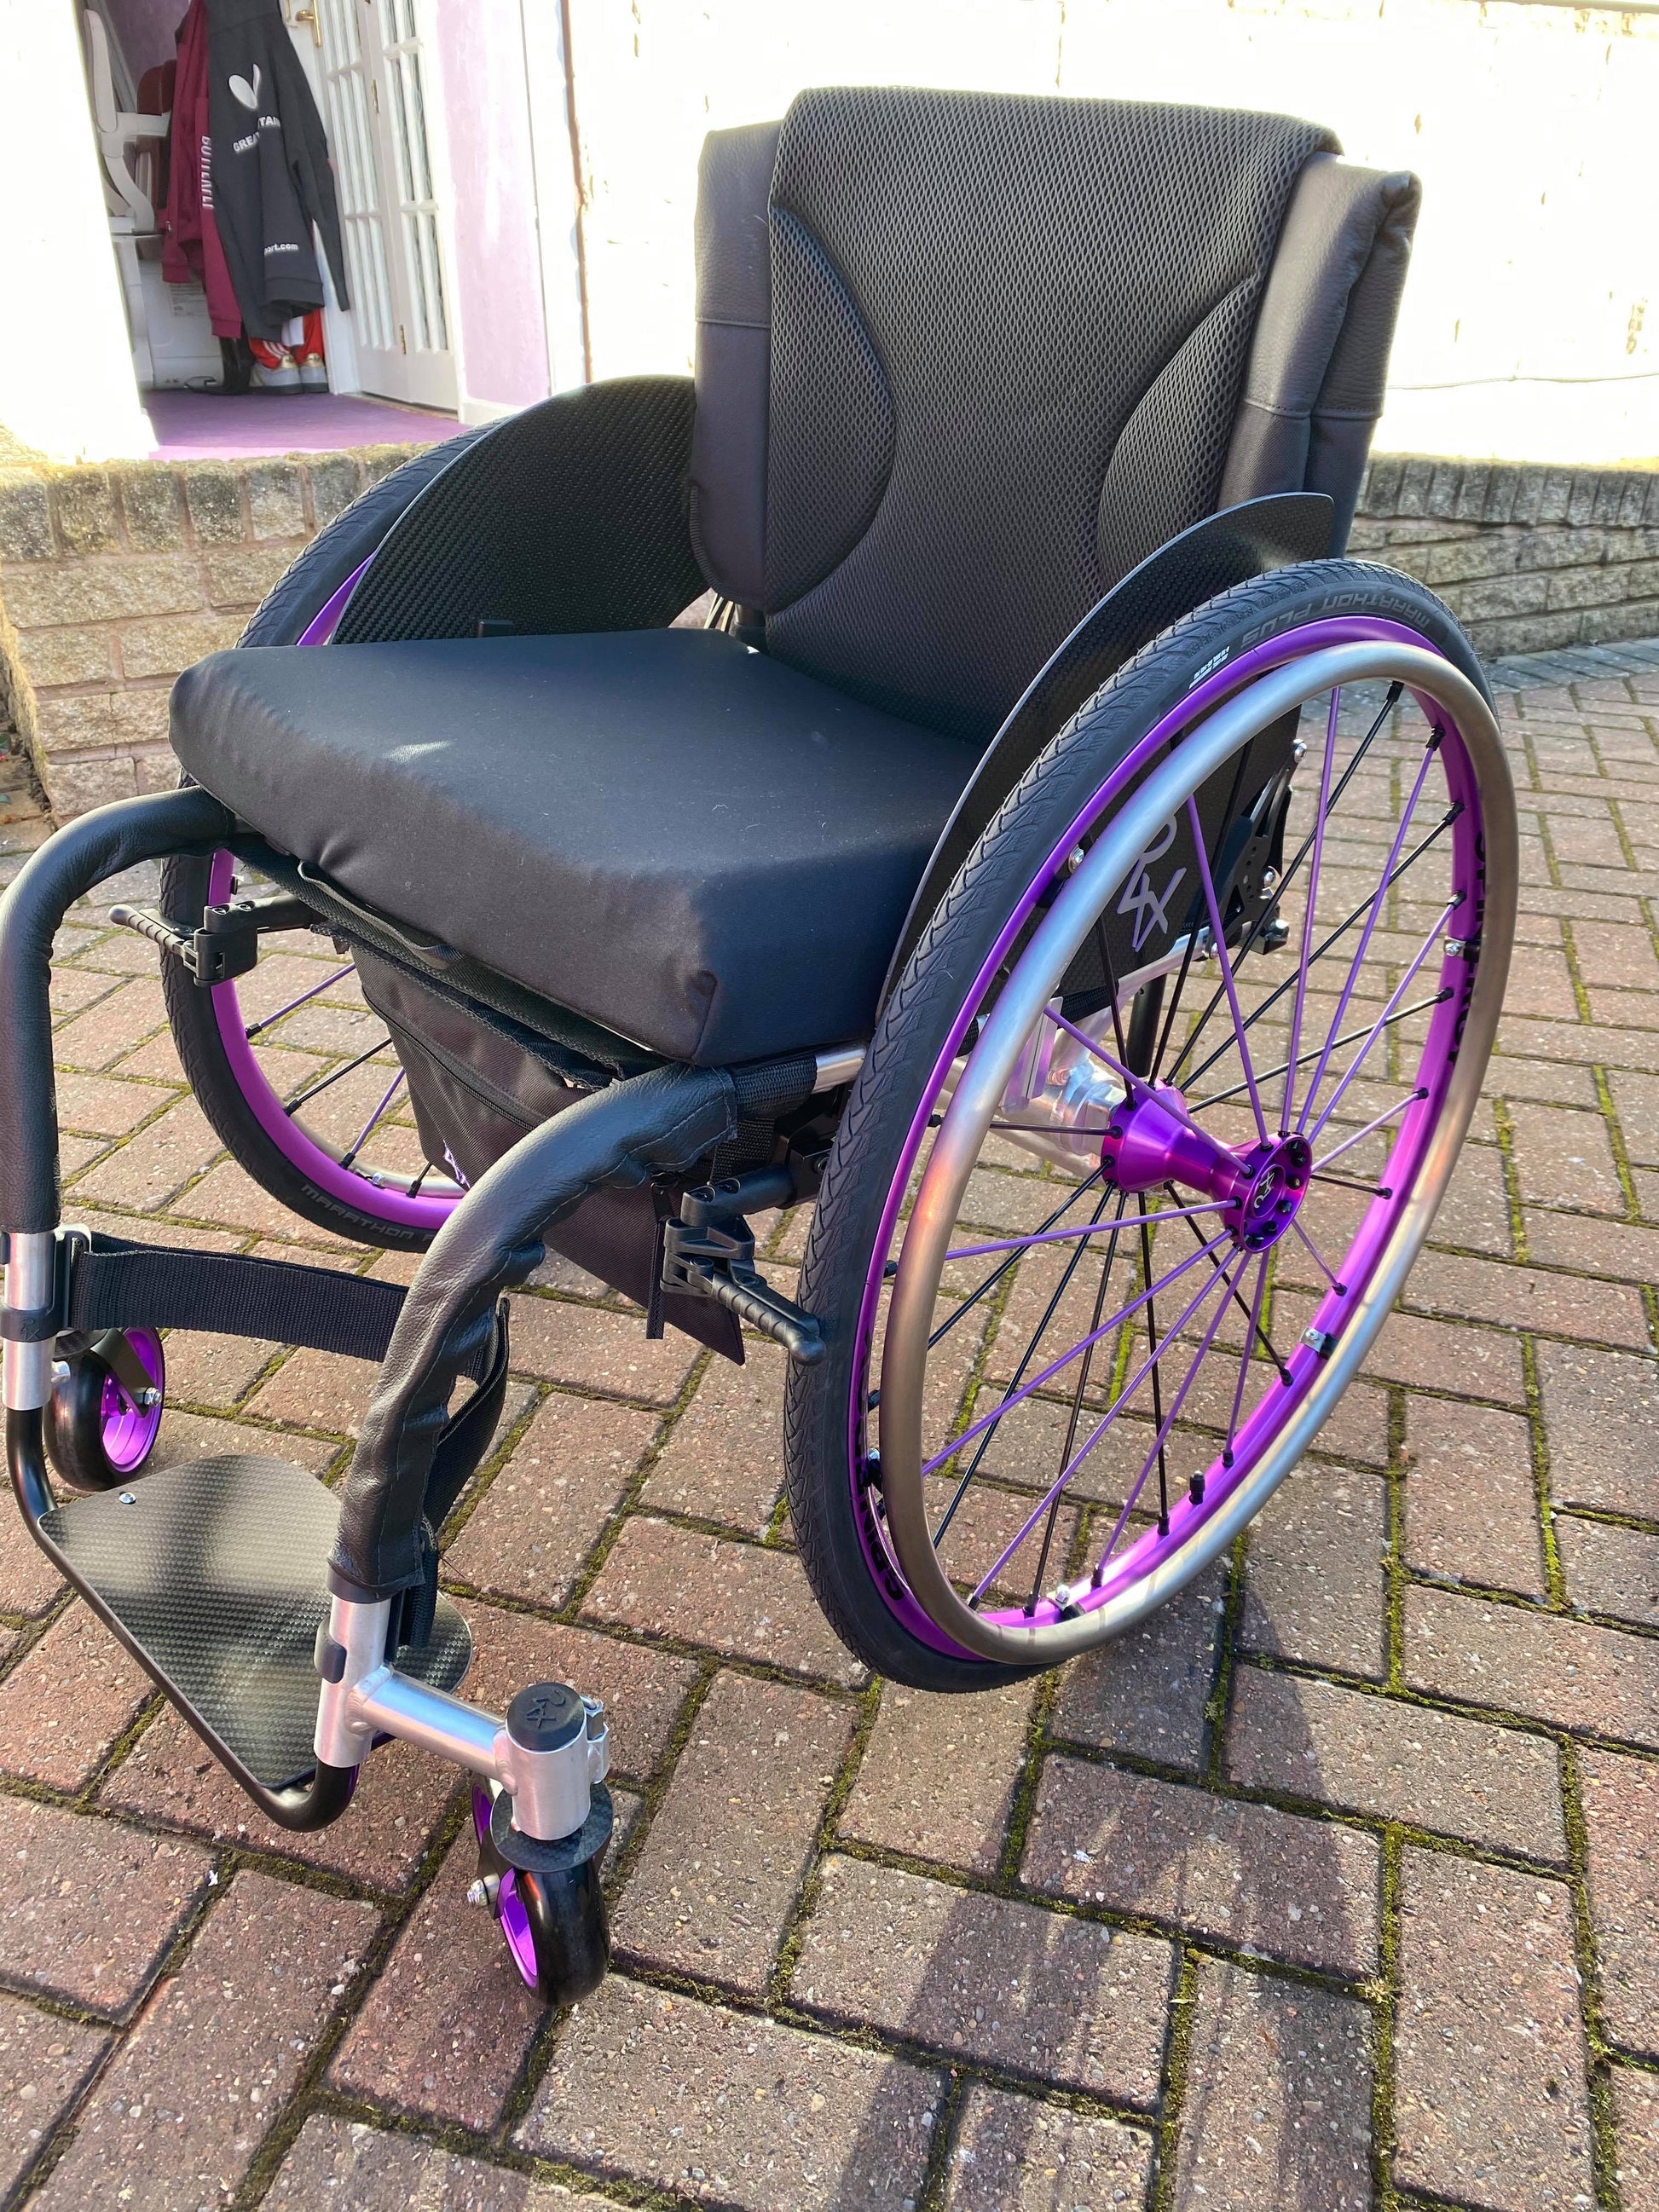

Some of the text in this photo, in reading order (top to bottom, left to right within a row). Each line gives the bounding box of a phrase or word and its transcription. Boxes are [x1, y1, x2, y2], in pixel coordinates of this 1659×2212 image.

[1241, 605, 1315, 648] PLUS
[1321, 593, 1431, 629] MARATHON
[301, 1185, 414, 1239] MARATHON
